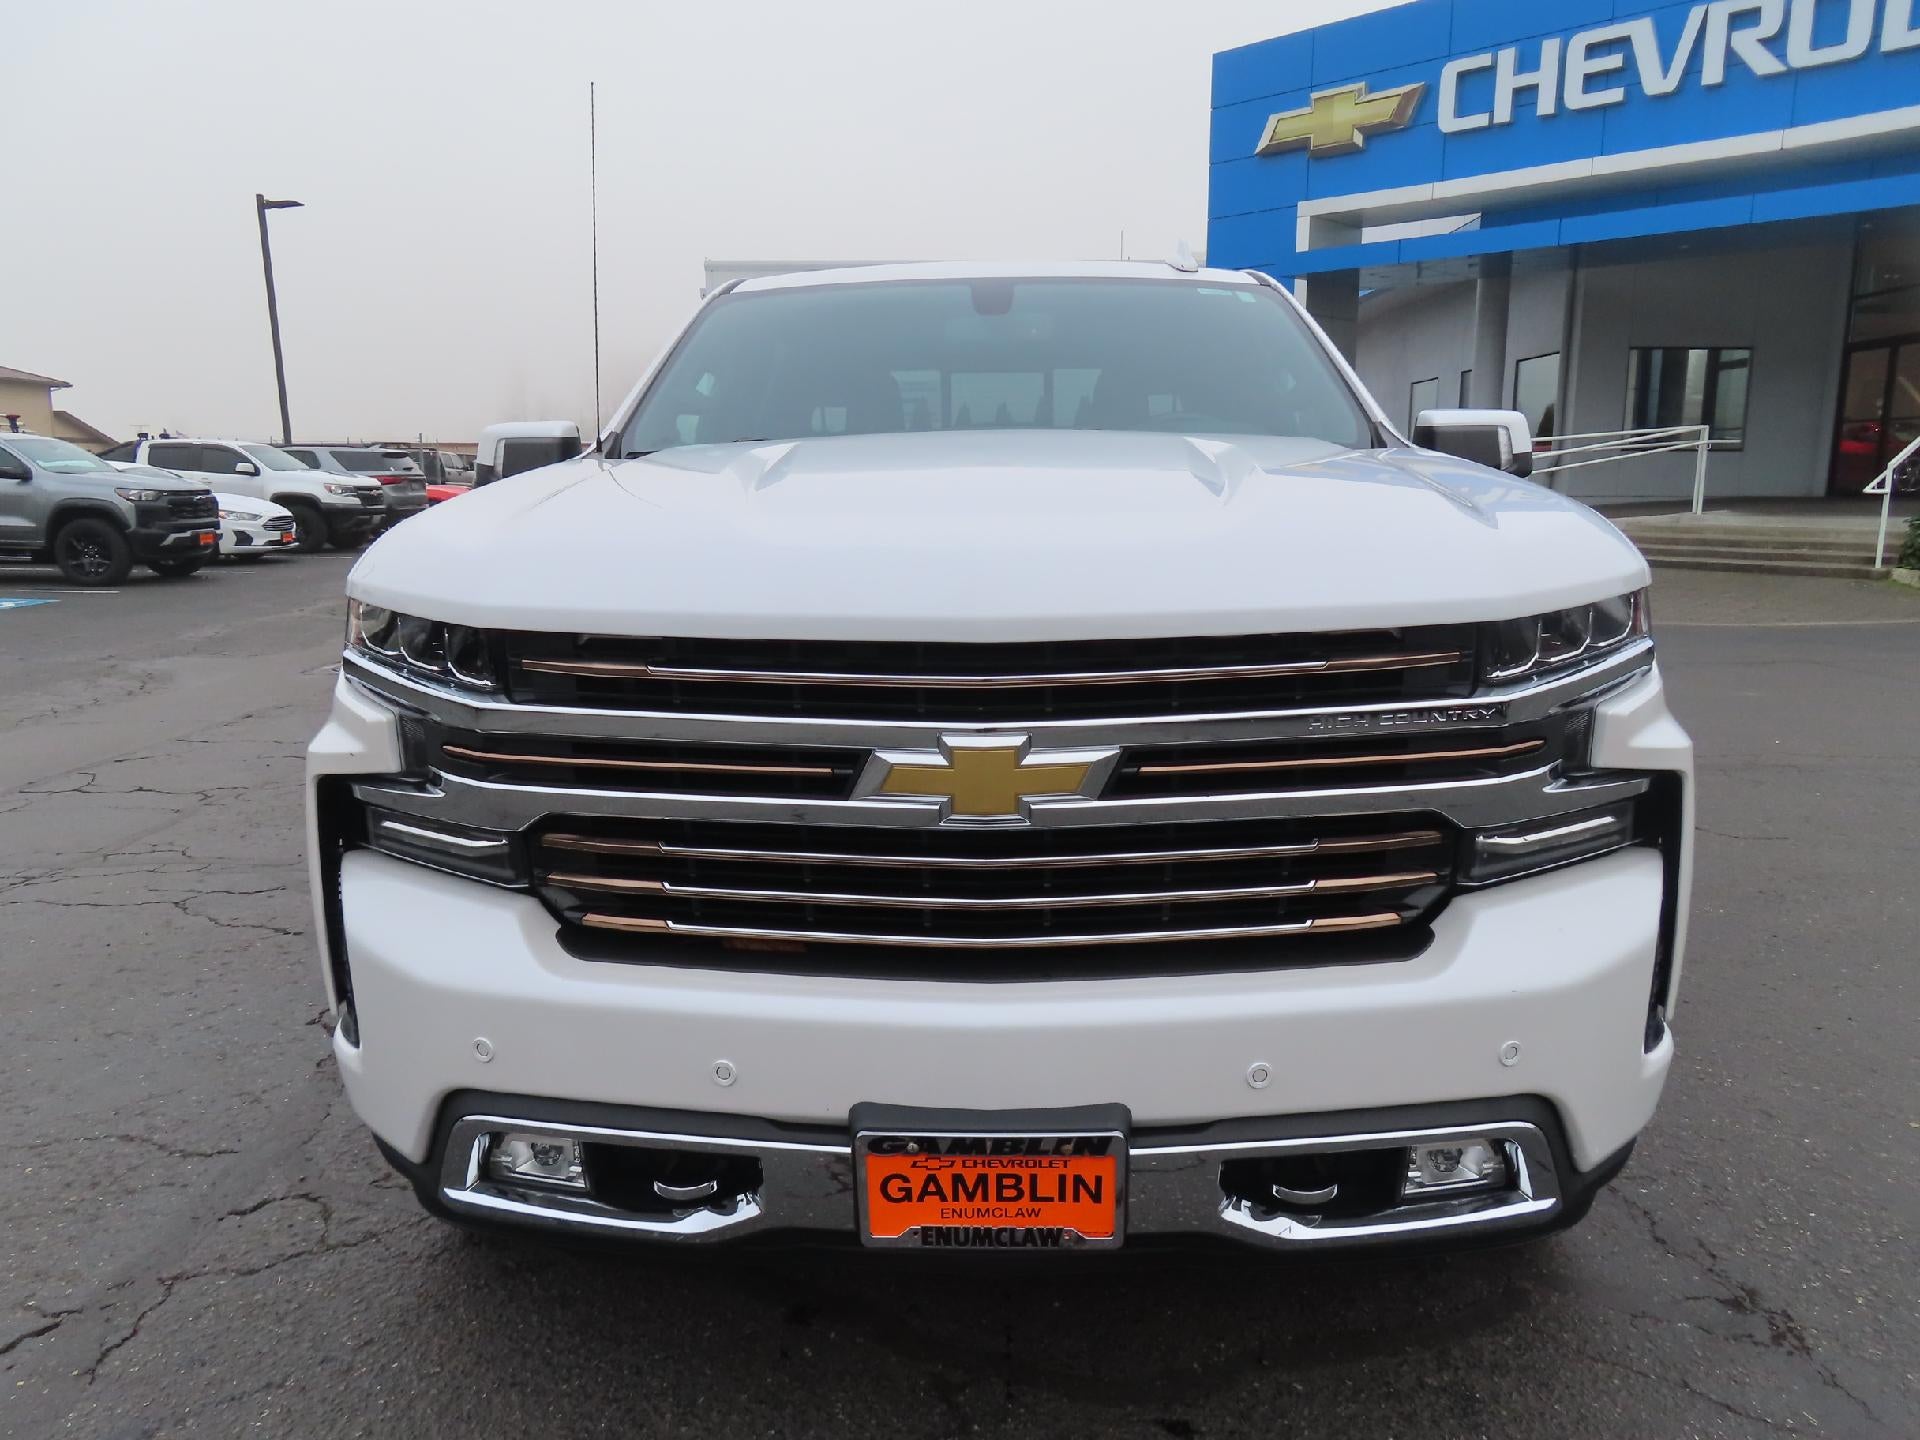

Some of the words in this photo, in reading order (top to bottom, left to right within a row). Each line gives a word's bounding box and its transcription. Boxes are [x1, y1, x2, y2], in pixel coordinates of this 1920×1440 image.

[1379, 708, 1496, 726] COUNTRY
[961, 1159, 1071, 1169] CHEVROLET
[879, 1173, 1103, 1204] GAMBLIN
[940, 1207, 1042, 1219] ENUMCLAW
[920, 1226, 1064, 1247] ENUMCLAW
